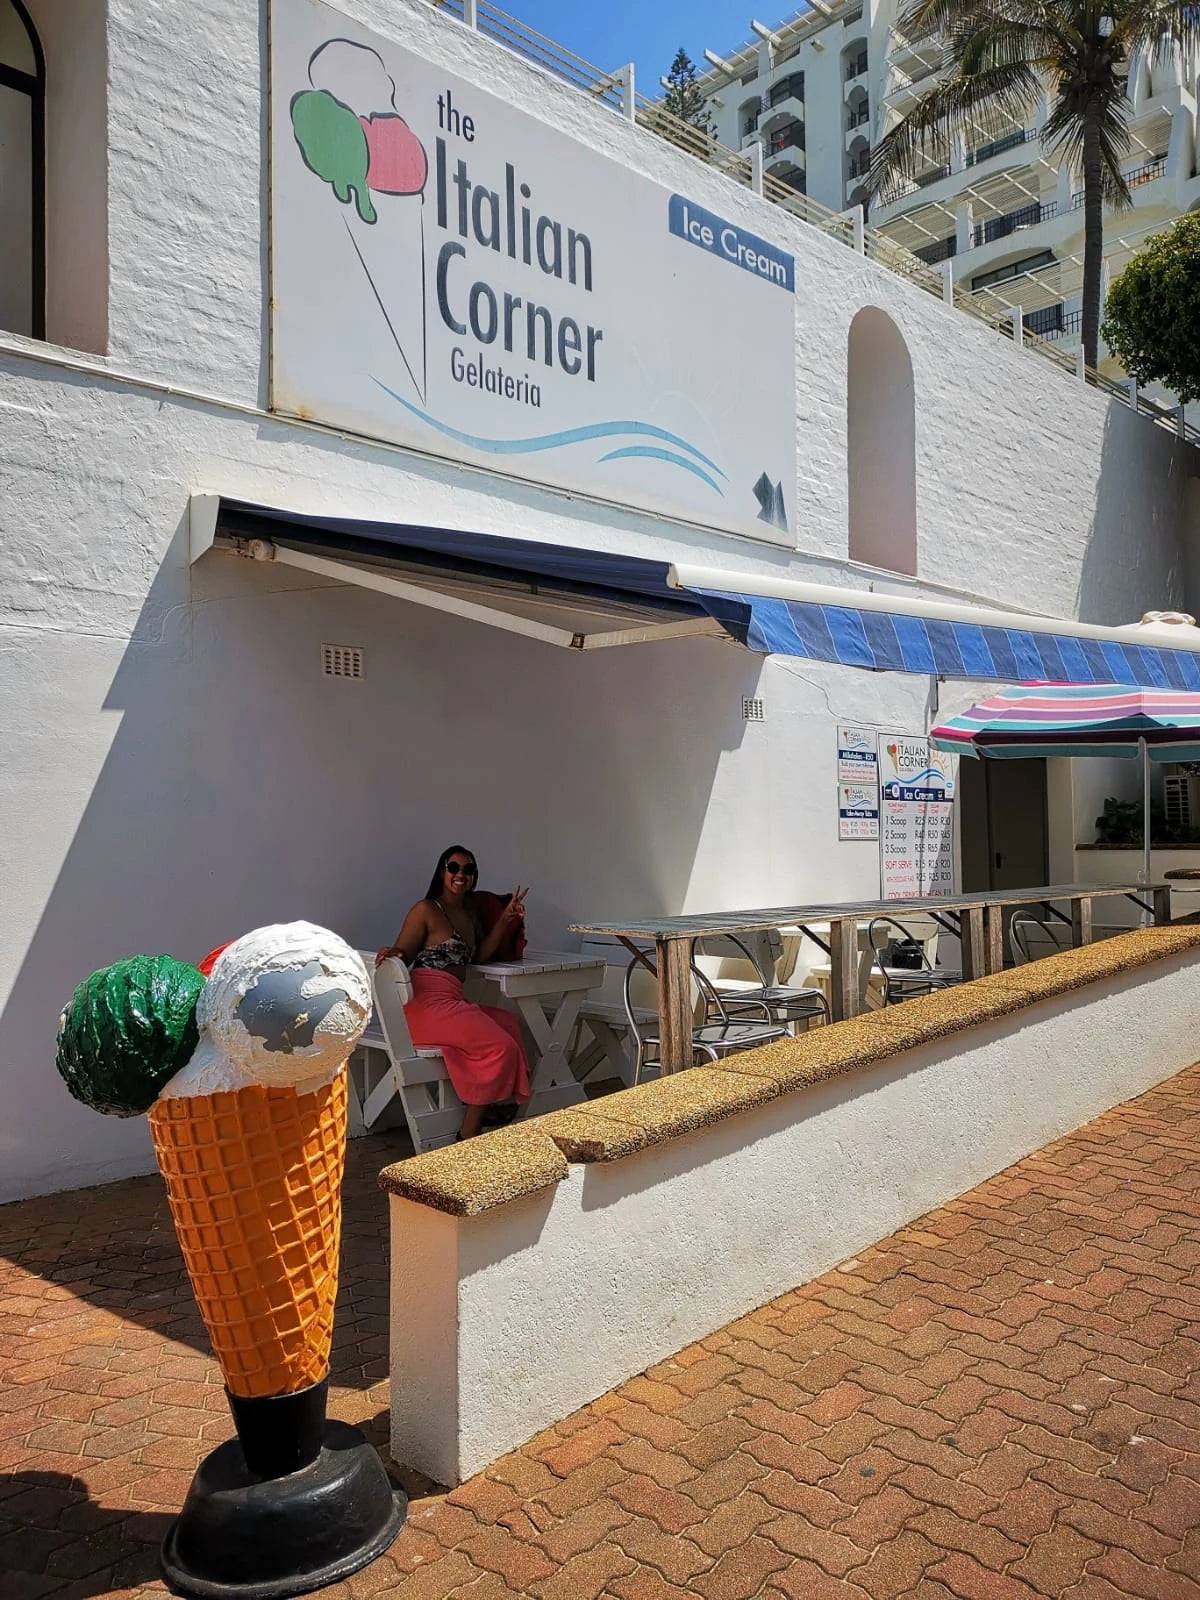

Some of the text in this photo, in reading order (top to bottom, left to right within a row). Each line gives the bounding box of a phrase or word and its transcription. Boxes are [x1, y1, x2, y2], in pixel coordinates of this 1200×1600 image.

[437, 89, 475, 142] the
[436, 136, 593, 292] Italian
[683, 206, 787, 284] Ice Cream
[436, 241, 603, 382] Corner
[451, 346, 541, 408] Gelateria
[897, 744, 926, 757] ITALIAN
[898, 755, 929, 768] CORNER
[904, 789, 913, 800] Ice
[914, 789, 934, 800] Cream
[890, 815, 907, 827] Scoop
[928, 816, 939, 826] R35
[941, 816, 951, 826] R30
[890, 829, 907, 841] Scoop
[890, 843, 907, 855] Scoop
[885, 860, 897, 870] SOFT
[898, 860, 913, 870] SERVE
